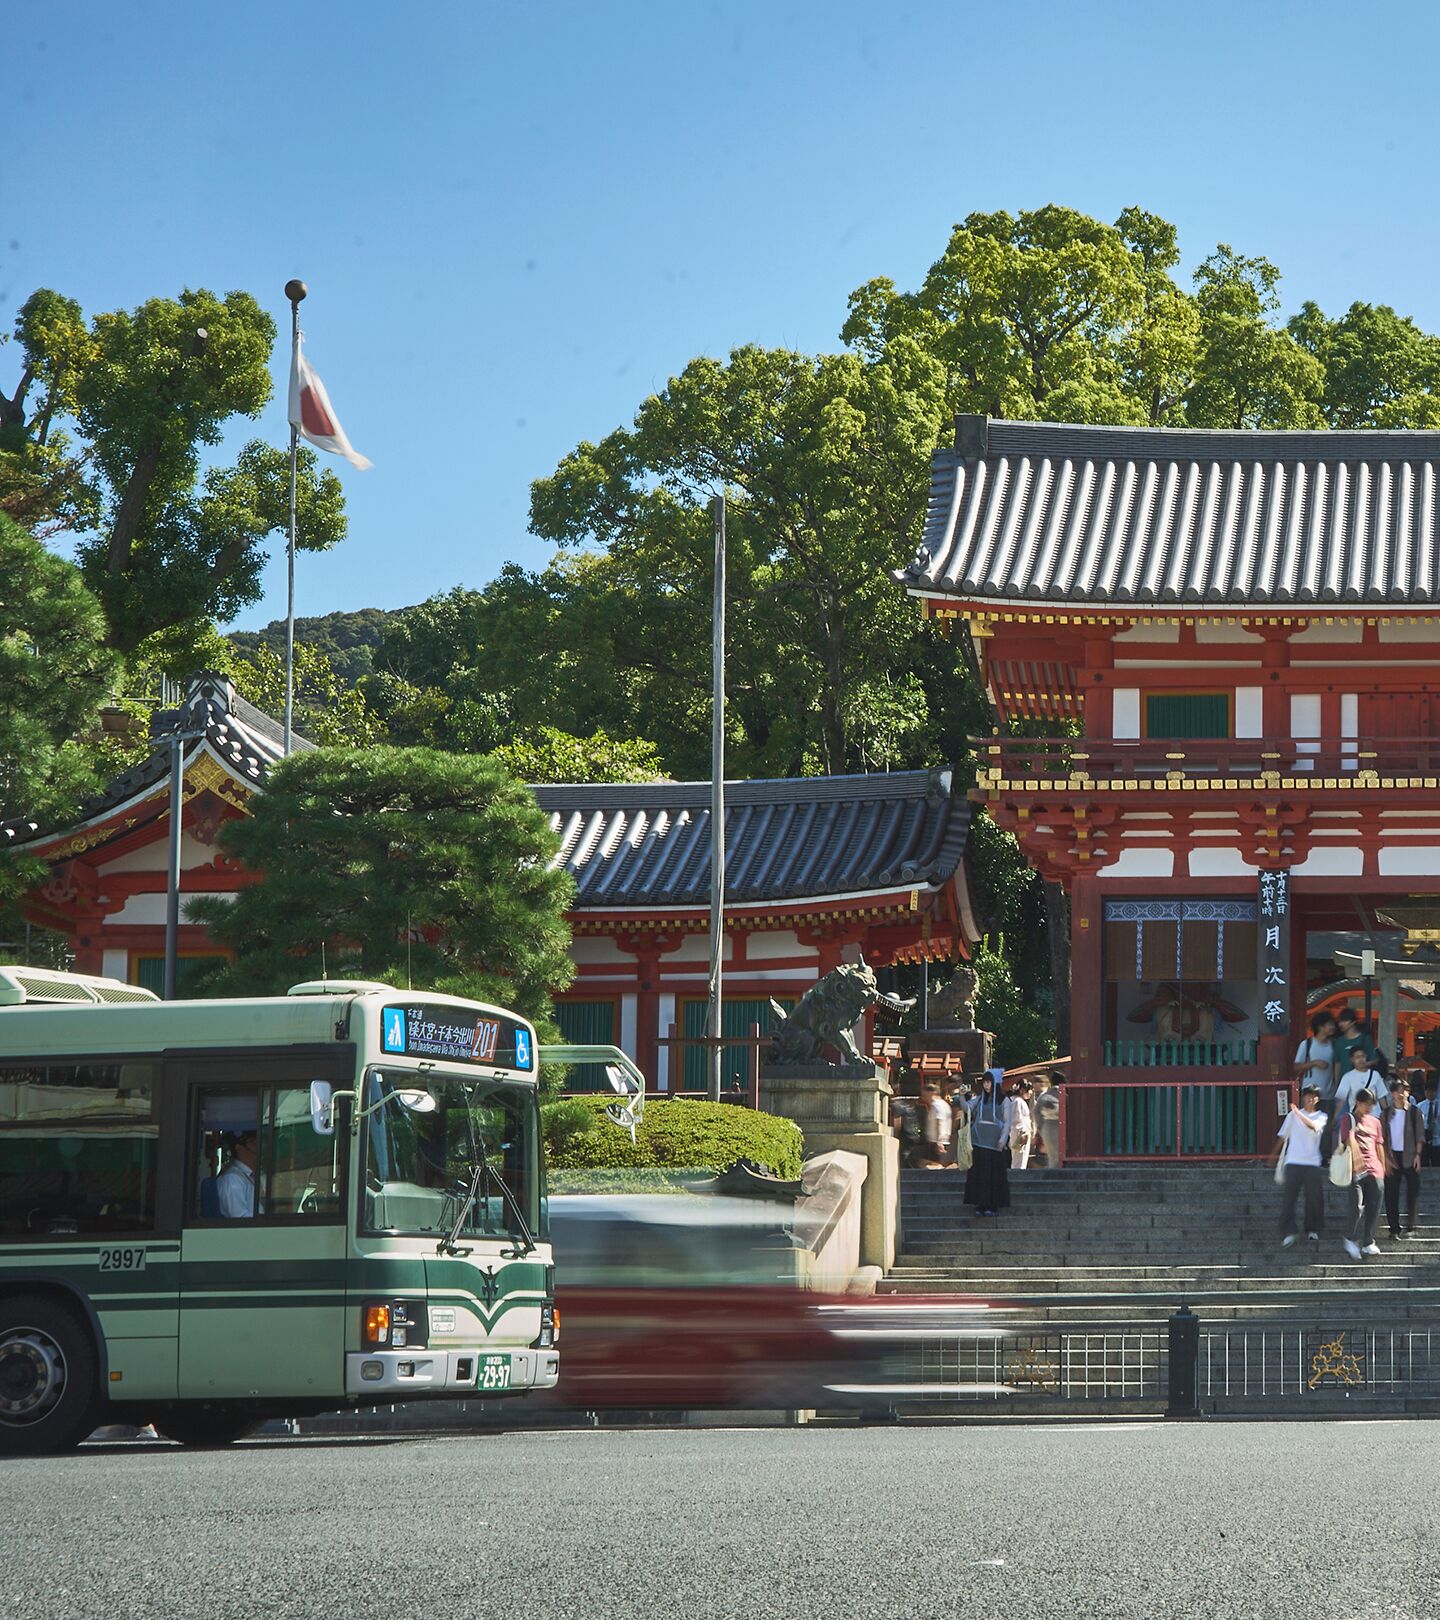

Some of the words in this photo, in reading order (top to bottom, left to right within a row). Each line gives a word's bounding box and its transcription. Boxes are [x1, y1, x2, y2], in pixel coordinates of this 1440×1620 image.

[1261, 871, 1276, 917] 午前十時
[1275, 870, 1288, 915] 十月十三日
[1264, 925, 1286, 1023] 月次祭
[472, 1021, 498, 1058] 201
[101, 1249, 144, 1270] 2997
